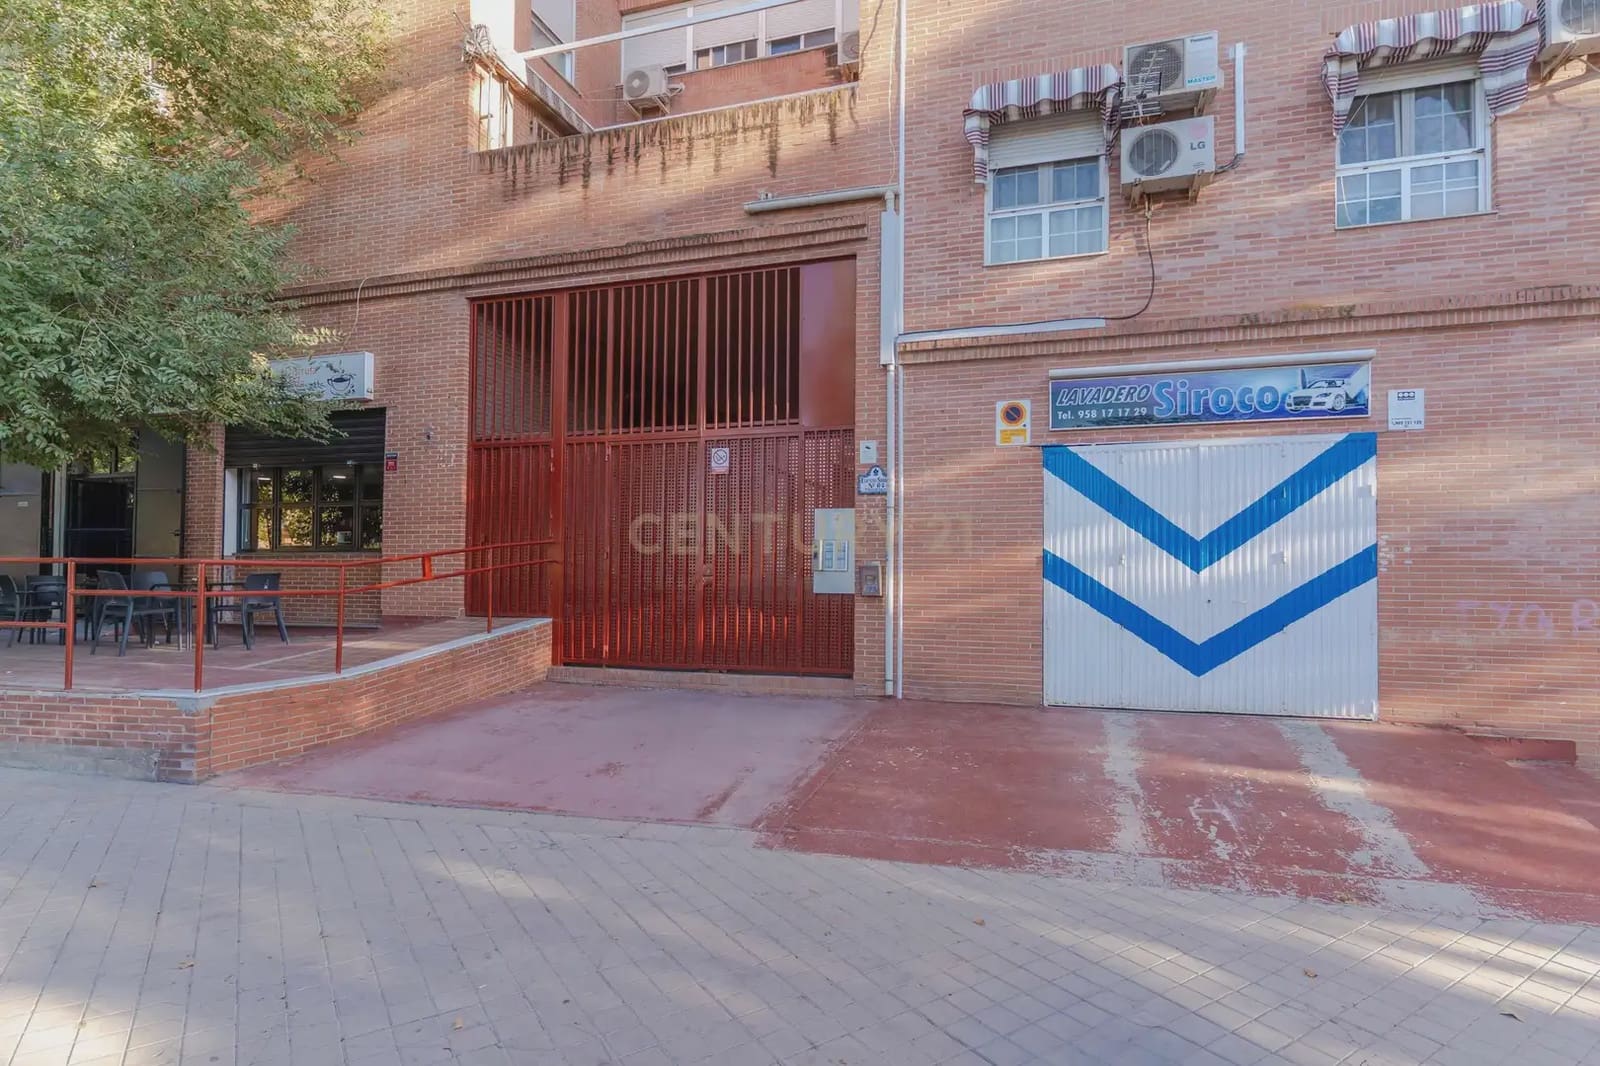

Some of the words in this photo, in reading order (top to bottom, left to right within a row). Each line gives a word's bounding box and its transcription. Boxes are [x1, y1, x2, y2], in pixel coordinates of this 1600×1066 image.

[1190, 141, 1206, 151] LG
[1056, 384, 1152, 406] LAVADERO
[1152, 379, 1281, 418] Siroco
[1057, 411, 1075, 420] Tel.
[1078, 409, 1097, 419] 958
[1101, 408, 1114, 418] 17
[1118, 407, 1131, 417] 17
[1134, 407, 1148, 416] 29
